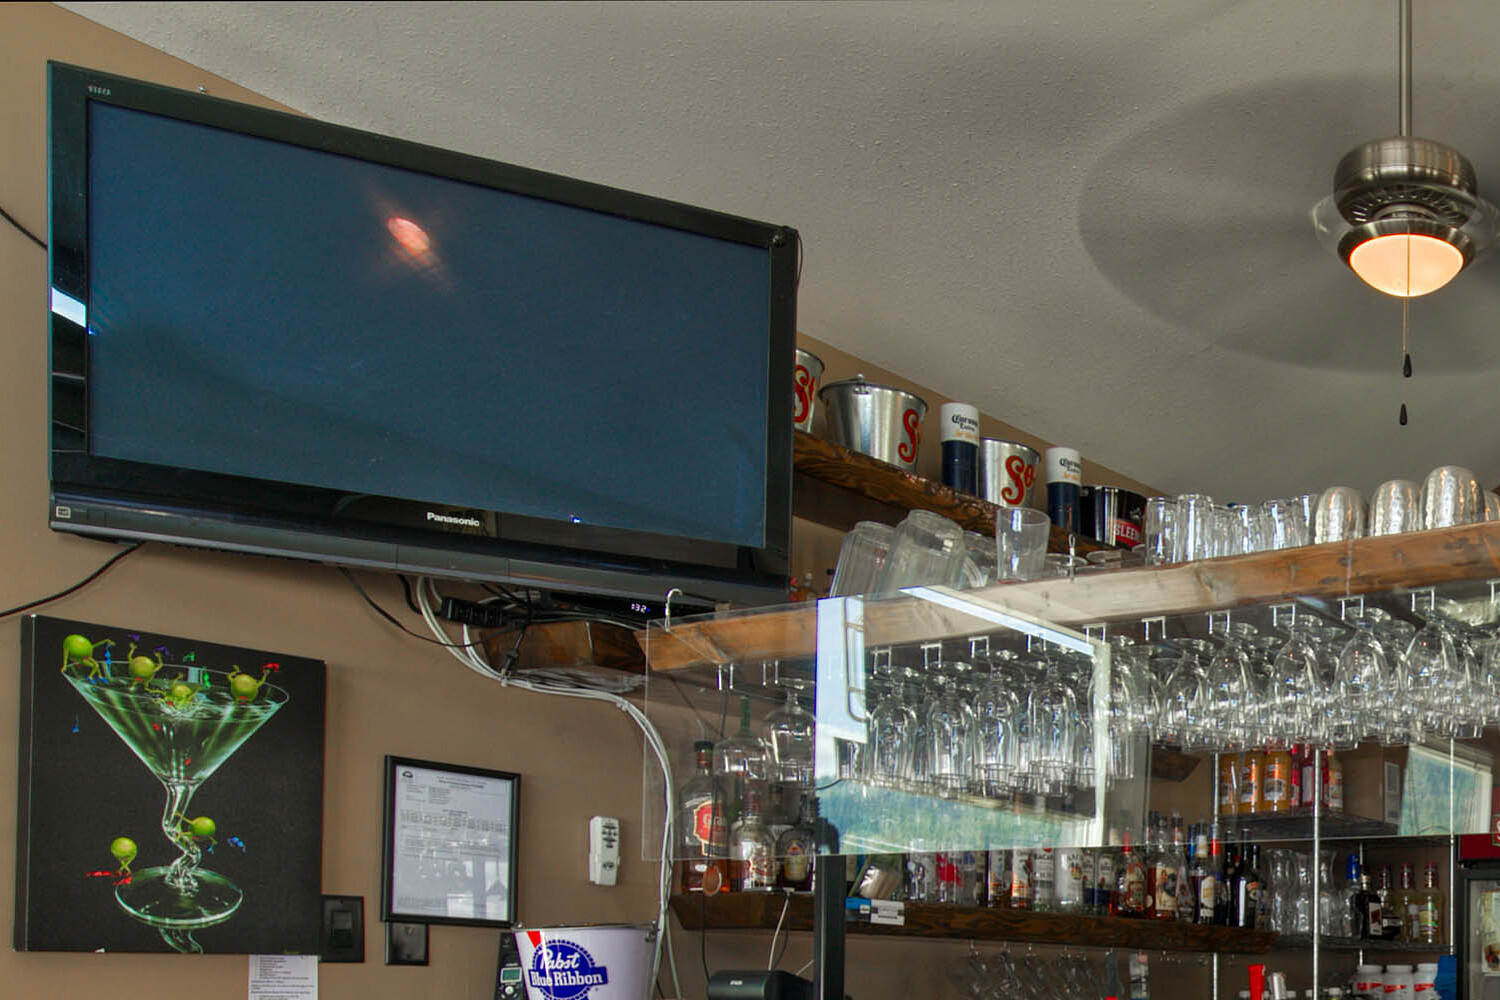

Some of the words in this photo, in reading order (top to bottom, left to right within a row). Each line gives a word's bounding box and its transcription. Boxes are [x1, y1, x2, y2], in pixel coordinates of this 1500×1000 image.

[426, 511, 481, 527] Panasonic
[537, 947, 581, 971] Pabst
[529, 970, 553, 987] Blue
[553, 969, 605, 988] Ribbon
